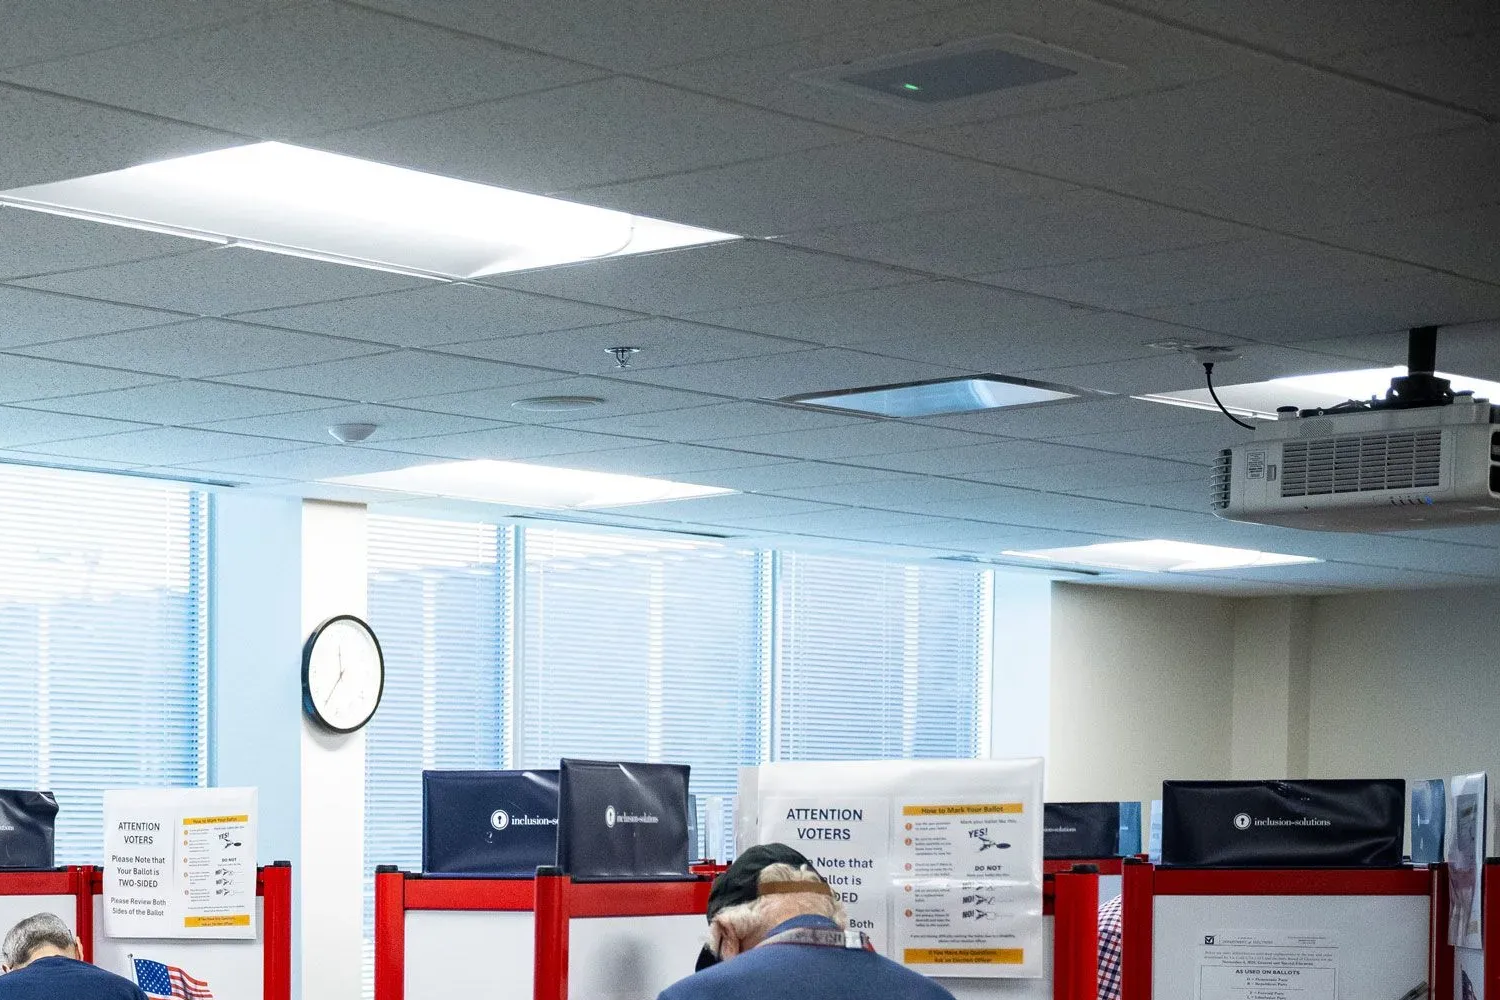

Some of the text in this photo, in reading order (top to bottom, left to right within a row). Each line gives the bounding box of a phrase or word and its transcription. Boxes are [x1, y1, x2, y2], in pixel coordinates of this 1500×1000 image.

[787, 808, 863, 820] ATTENTION
[1255, 817, 1331, 826] inclusion-solutions
[119, 822, 160, 831] ATTENTION
[798, 828, 850, 840] VOTERS
[968, 828, 988, 838] YES!
[124, 836, 153, 844] VOTERS
[112, 855, 133, 863] Please
[152, 856, 165, 864] that
[817, 857, 845, 868] Note
[849, 858, 873, 868] that
[117, 867, 131, 875] Your
[119, 879, 158, 888] TWO-SIDED
[852, 876, 861, 885] is
[147, 908, 164, 916] Ballot
[850, 919, 874, 929] Both
